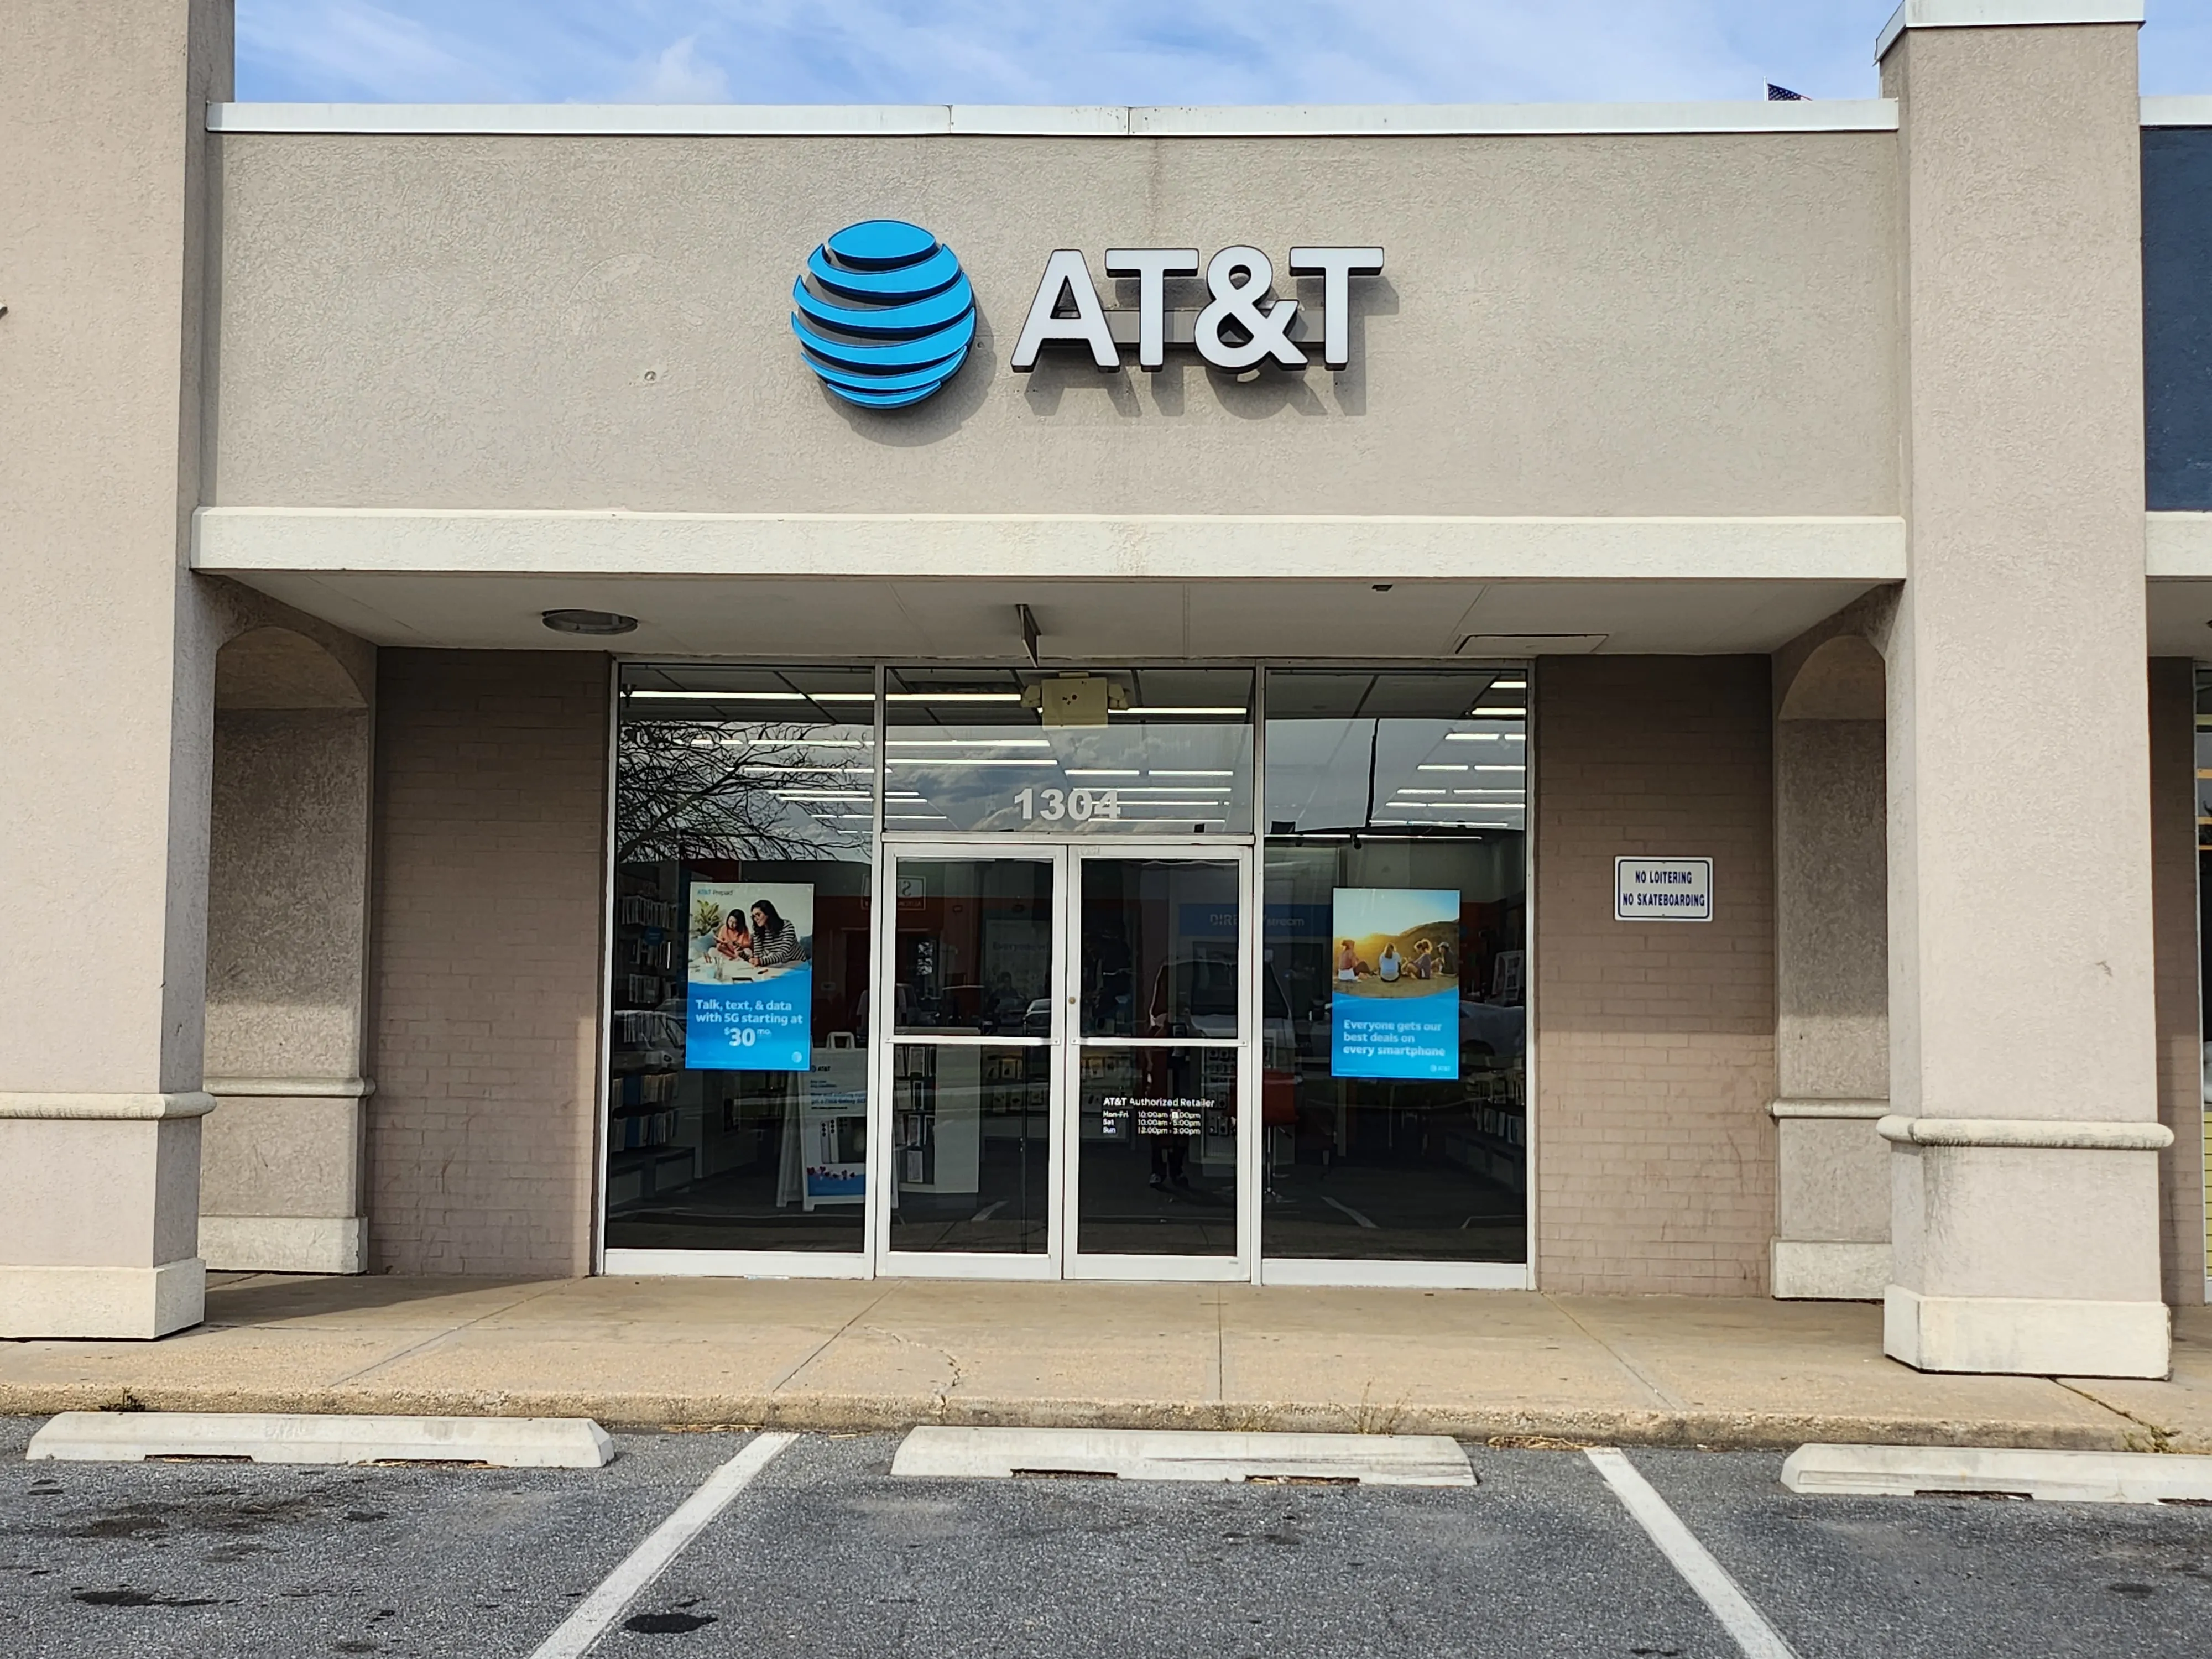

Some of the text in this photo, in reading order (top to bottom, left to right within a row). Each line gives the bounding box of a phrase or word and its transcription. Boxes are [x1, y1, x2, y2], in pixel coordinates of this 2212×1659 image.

[1010, 245, 1385, 372] AT&T
[1014, 788, 1121, 821] 1304
[1635, 871, 1692, 884] NO LOITERING
[1623, 893, 1705, 907] NO SKATEBOARDING
[695, 999, 792, 1012] Talk, text, & data
[695, 1011, 803, 1026] with 5G starting at
[1343, 1019, 1442, 1032] Everyone gets our
[1343, 1031, 1415, 1044] best deals on
[1343, 1046, 1446, 1058] every smartphone
[1103, 1097, 1215, 1108] AT&T Authorized Retailer
